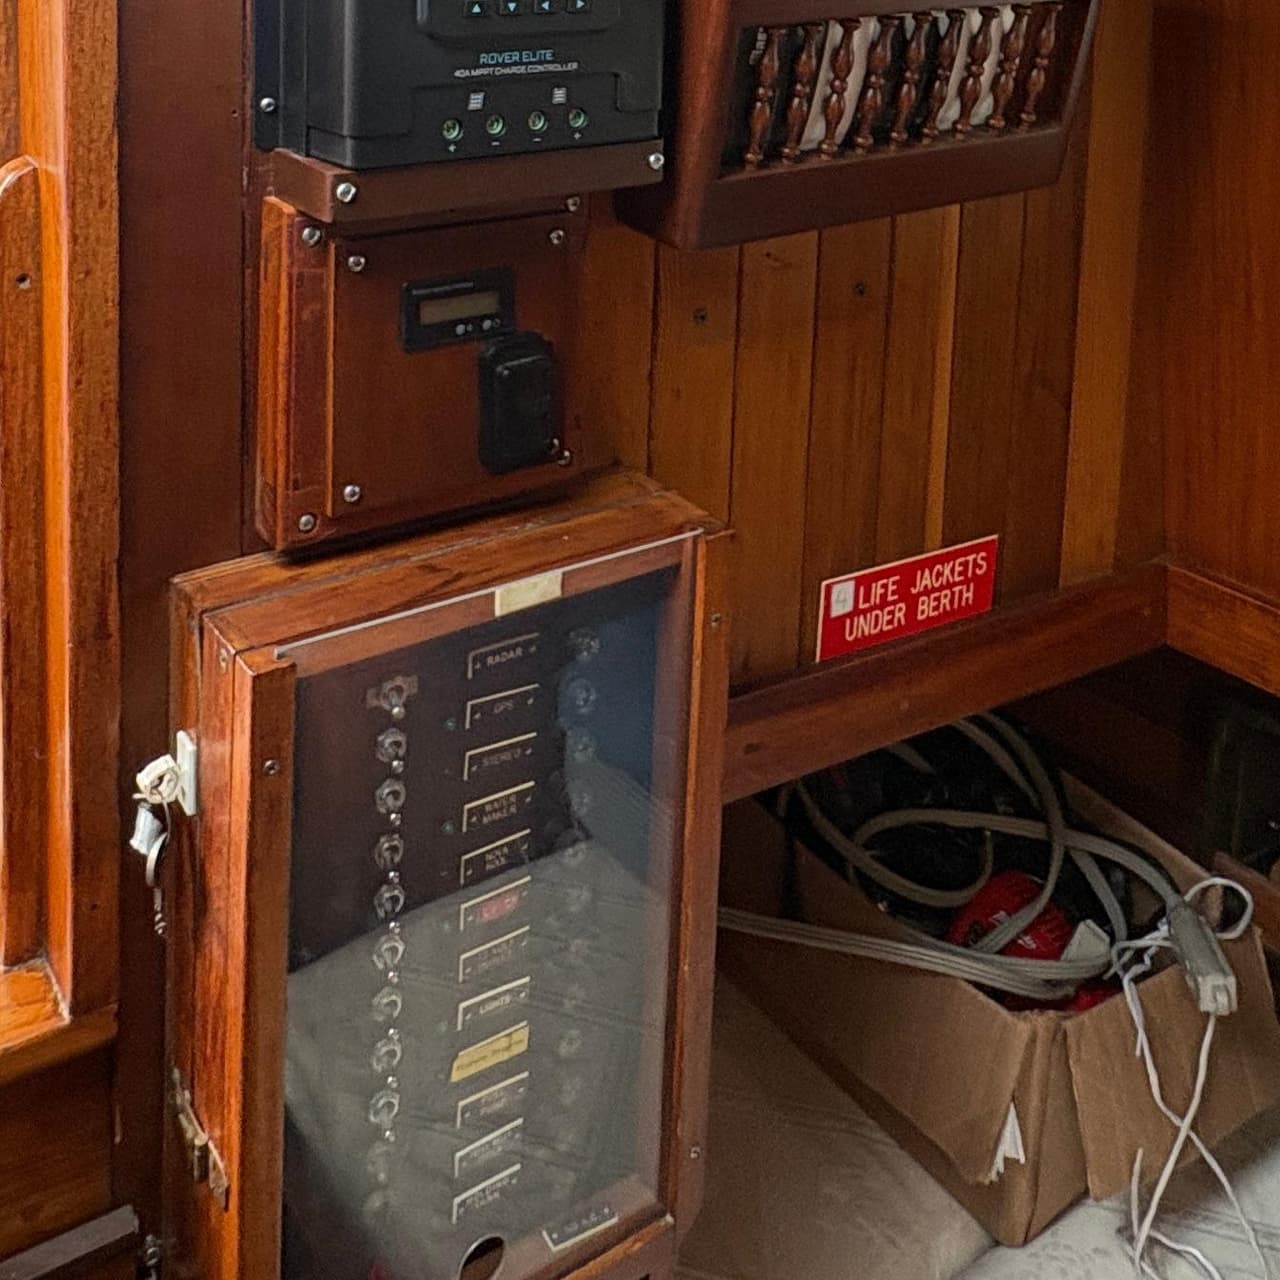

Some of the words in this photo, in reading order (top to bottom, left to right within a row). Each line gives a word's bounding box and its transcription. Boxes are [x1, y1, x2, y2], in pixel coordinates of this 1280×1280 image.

[479, 52, 520, 65] ROVER
[522, 49, 555, 63] ELITE
[471, 66, 494, 77] MPPT
[495, 64, 526, 76] CHARGE
[527, 61, 579, 74] CONTROLLER
[858, 575, 900, 609] LIFE
[910, 551, 988, 595] JACKETS
[844, 603, 906, 642] UNDER
[916, 582, 975, 621] BERTH
[486, 647, 523, 667] RADAR
